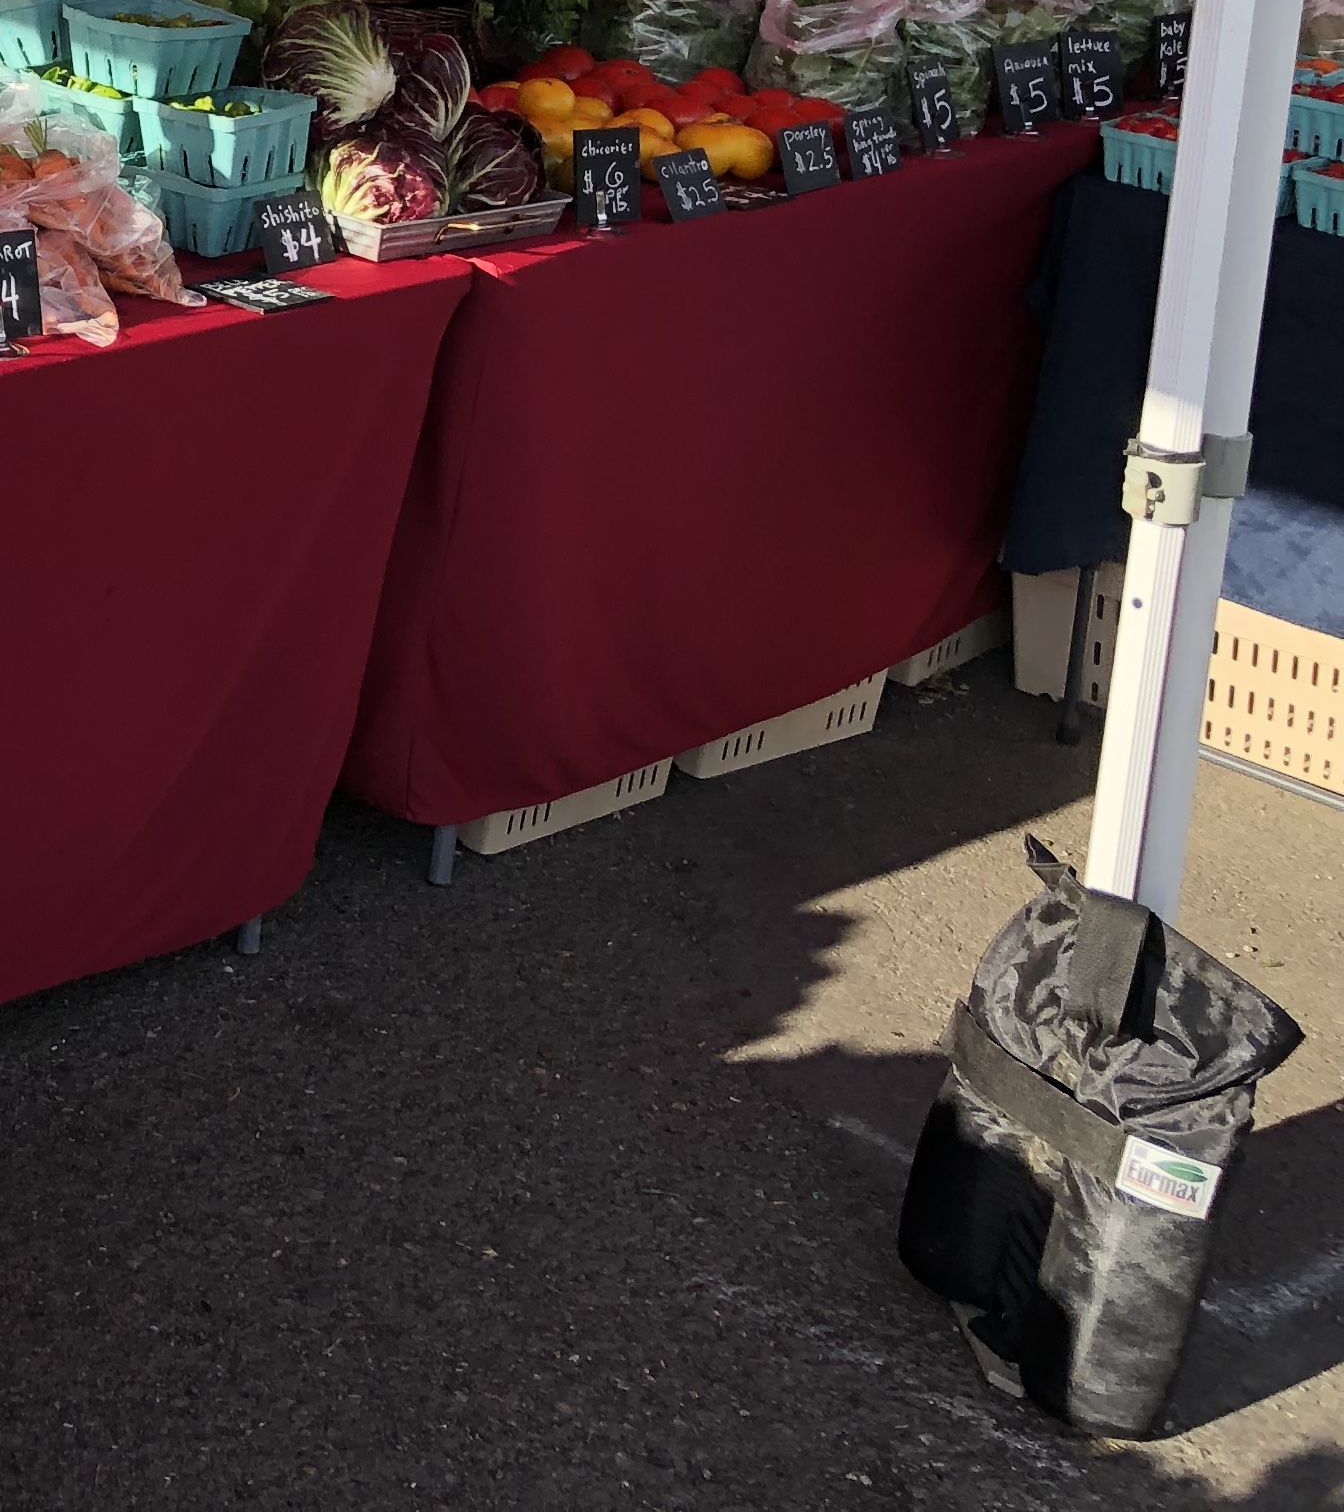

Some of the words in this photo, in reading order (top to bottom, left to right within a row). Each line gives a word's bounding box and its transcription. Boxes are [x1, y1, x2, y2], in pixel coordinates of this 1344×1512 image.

[1160, 20, 1186, 38] baby
[1068, 59, 1097, 74] mix
[261, 201, 320, 229] shishito
[1127, 1159, 1200, 1203] Eurmax
